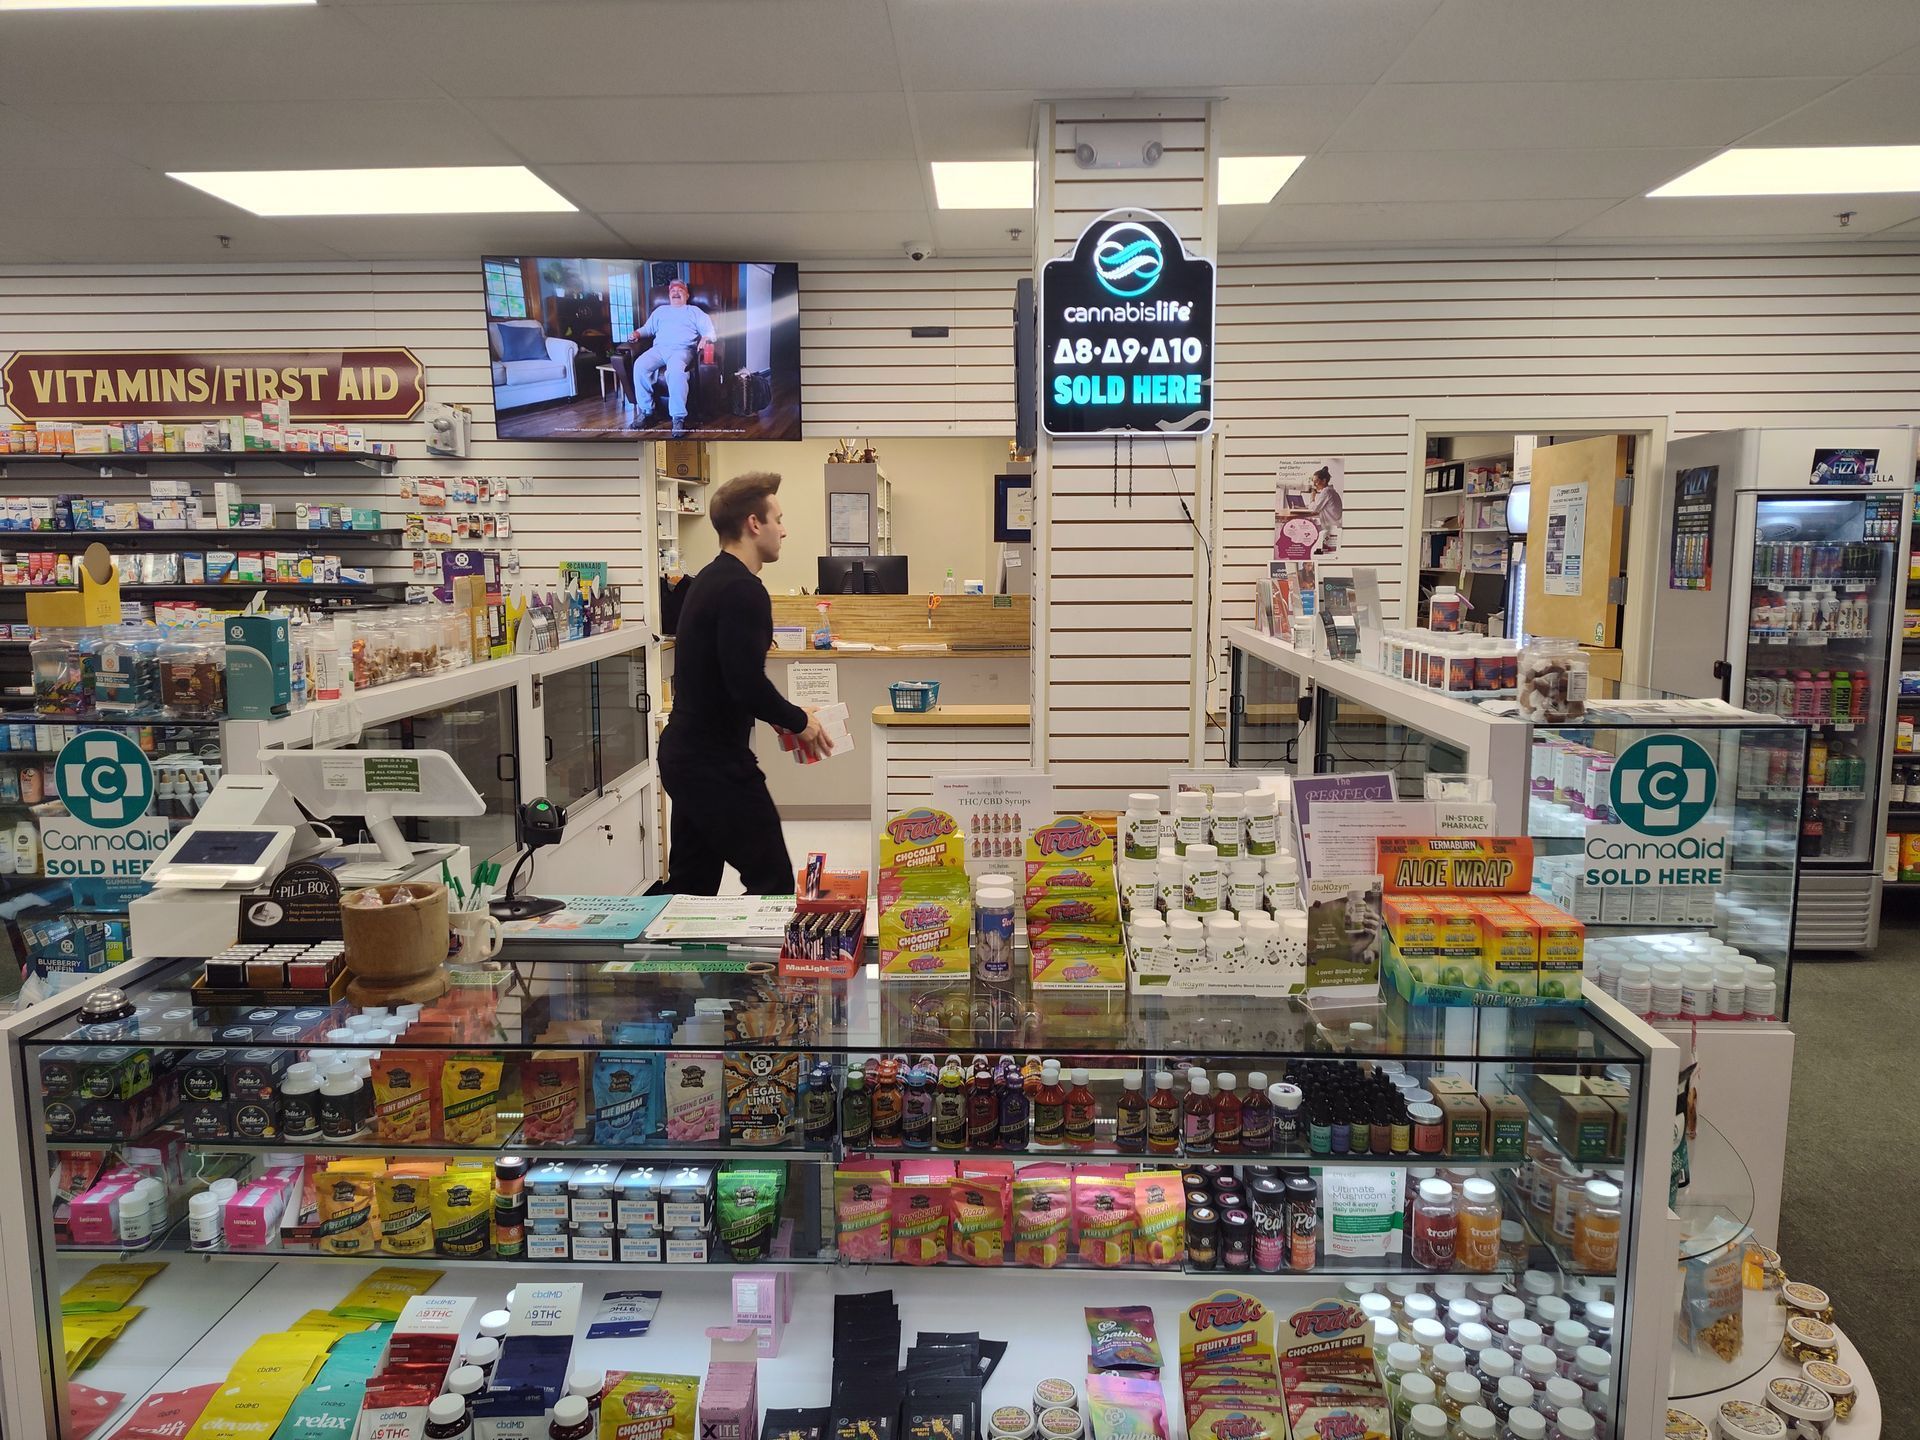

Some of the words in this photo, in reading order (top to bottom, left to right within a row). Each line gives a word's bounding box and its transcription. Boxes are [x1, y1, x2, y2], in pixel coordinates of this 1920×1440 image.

[1063, 300, 1192, 323] cannabislife
[29, 366, 328, 404] VITAMINS/FIRST
[337, 368, 399, 401] AID
[1054, 374, 1125, 404] SOLD
[1132, 374, 1202, 404] HERE
[1832, 462, 1860, 474] FIZZY
[1304, 786, 1386, 801] PERFECT
[958, 798, 1002, 807] THC/CBD
[1006, 798, 1031, 806] Syrups
[1444, 814, 1484, 822] IN-STORE
[1441, 821, 1489, 830] PHARMACY
[1429, 840, 1477, 850] TERMABURN
[1586, 837, 1724, 860] CannaAid
[894, 843, 946, 862] CHOCOLATE
[906, 854, 937, 868] CHUNK
[47, 860, 110, 876] SOLD
[113, 860, 151, 876] HER
[1396, 858, 1448, 888] ALOE
[1454, 858, 1514, 888] WRAP
[1586, 868, 1651, 886] SOLD
[1658, 868, 1722, 885] HERE
[280, 884, 305, 898] PILL
[308, 881, 330, 895] BOX
[898, 929, 949, 946] CHOCOLATE
[910, 940, 940, 952] CHUNK
[38, 959, 82, 968] BLUEBERRY
[786, 964, 829, 972] MaxLight
[1472, 993, 1499, 1006] ALOE
[1504, 996, 1537, 1007] WRAP
[746, 1086, 782, 1097] LEGAL
[397, 1094, 422, 1109] ORANGE
[558, 1093, 570, 1104] PIE
[698, 1094, 715, 1106] CAKE
[747, 1095, 781, 1105] LIMITS
[601, 1106, 617, 1119] BLUE
[618, 1098, 644, 1114] DREAM
[1273, 1116, 1296, 1130] Peak
[1332, 1184, 1375, 1194] Ultimate
[1332, 1192, 1387, 1201] Mushroom
[962, 1207, 988, 1218] Peach
[1145, 1203, 1170, 1215] Peach
[905, 1216, 936, 1228] LEMONADE
[532, 1290, 563, 1299] cbdMD
[430, 1310, 454, 1318] THC
[543, 1310, 562, 1320] THC
[1189, 1296, 1267, 1332] Treats
[1290, 1304, 1368, 1337] Treats
[1097, 1330, 1153, 1345] Rainbow
[1196, 1338, 1230, 1353] FRUITY
[1231, 1334, 1252, 1345] RICE
[1206, 1348, 1227, 1357] CEREAL
[1228, 1345, 1241, 1353] BAR
[1287, 1340, 1342, 1358] CHOCOLATE
[1342, 1336, 1363, 1347] RICE
[380, 1410, 408, 1420] cbdMD
[202, 1419, 272, 1432] elevate
[294, 1413, 352, 1430] relax
[496, 1420, 525, 1430] cbdMD
[617, 1418, 674, 1436] CHOCOLATE
[387, 1429, 410, 1439] THC
[629, 1428, 663, 1440] CHUNK
